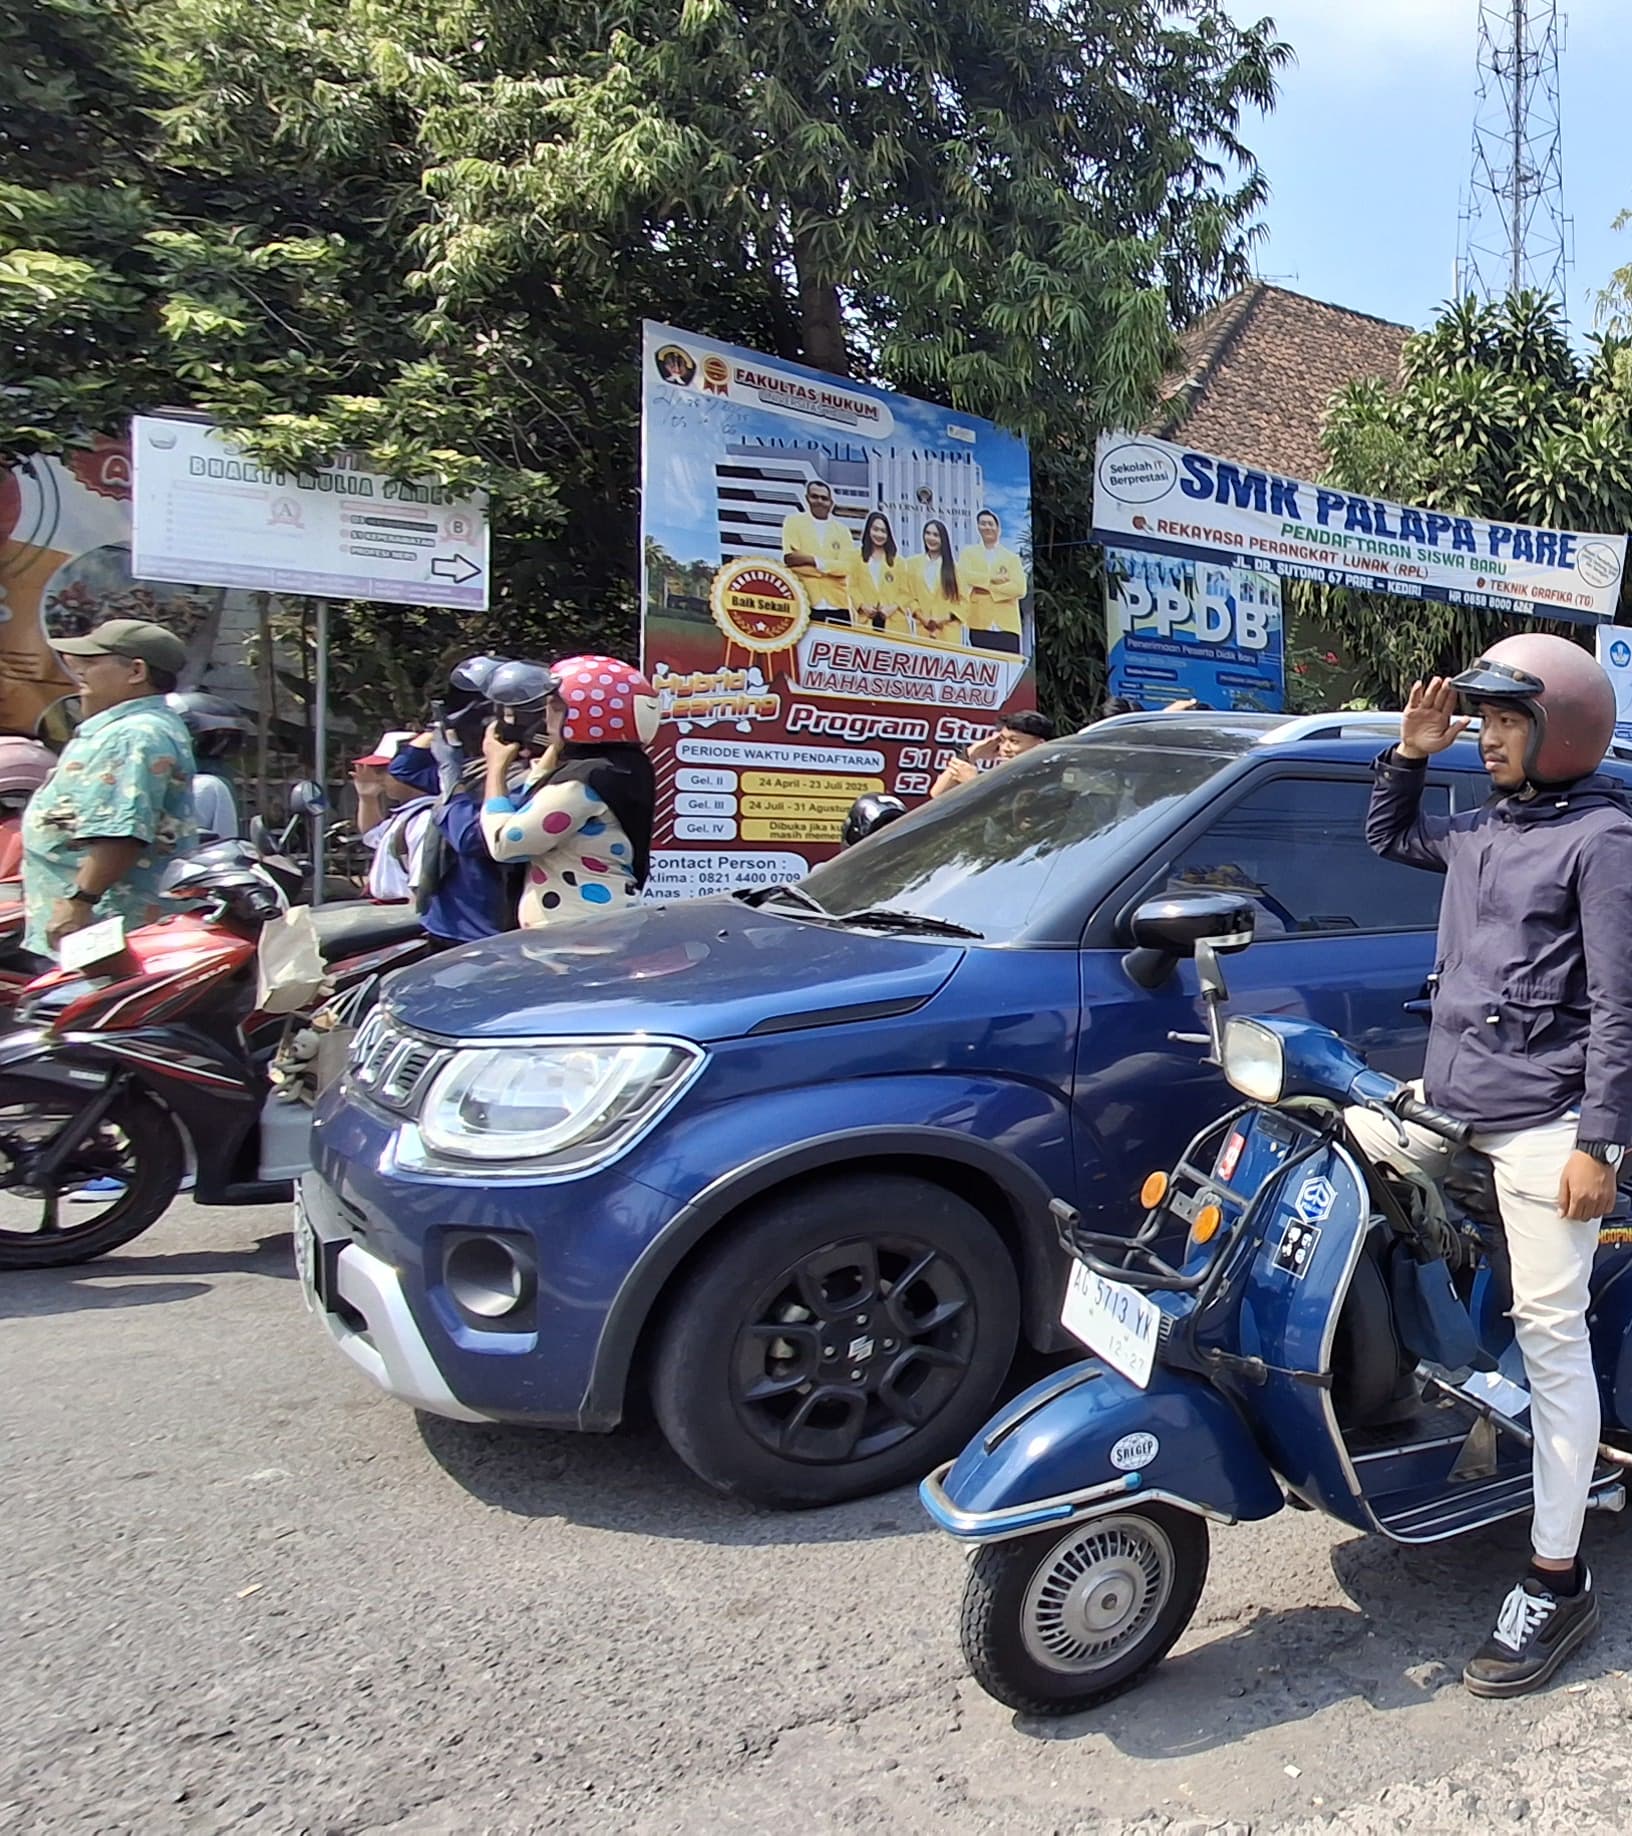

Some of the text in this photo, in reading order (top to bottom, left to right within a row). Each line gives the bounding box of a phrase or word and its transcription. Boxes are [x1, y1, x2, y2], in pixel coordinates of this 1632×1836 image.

[736, 368, 878, 419] FAKULTAS HUKUM
[190, 456, 286, 486] BHAKTI
[1110, 461, 1152, 474] Sekolah
[1109, 471, 1169, 487] Berprestasi
[1180, 453, 1302, 520] SMK
[1316, 488, 1477, 554] PALAPA
[1488, 524, 1578, 570] PARE
[453, 520, 464, 534] B
[1157, 518, 1429, 580] REKAYASA PERANGKAT LUNAK (RPL)
[1280, 522, 1508, 577] PENDAFTARAN SISWA BARU
[1277, 562, 1325, 583] SUTOMO
[1328, 571, 1342, 585] 67
[1345, 574, 1374, 590] PARE
[1387, 581, 1422, 597] KEDIRI
[1490, 579, 1528, 598] TEKNIK
[1531, 586, 1573, 603] GRAFIKA
[731, 595, 791, 613] Baik Sekali
[1117, 577, 1269, 650] PPDB
[1127, 637, 1181, 652] Penerimaan
[809, 641, 998, 686] PENERIMAAN
[653, 670, 747, 697] Hybrid
[805, 670, 997, 706] MAHASISWA BARU
[789, 705, 928, 741] Program
[681, 745, 880, 767] PERIODE WAKTU PENDAFTARAN
[690, 775, 714, 786] Gel.
[759, 777, 772, 787] 24
[774, 778, 800, 790] April
[809, 780, 821, 790] 23
[824, 780, 843, 791] Juli
[845, 781, 868, 791] 2025
[894, 772, 931, 794] S2
[688, 799, 712, 810] Gel.
[749, 801, 762, 810] 24
[764, 802, 785, 811] Juli
[794, 804, 806, 812] 31
[686, 823, 724, 834] Gel. IV
[769, 822, 807, 831] Dibuka
[809, 823, 828, 832] jika
[718, 856, 776, 870] Person
[699, 872, 730, 884] 0821
[735, 872, 767, 884] 4400
[770, 872, 801, 884] 0709
[643, 887, 681, 898] Anas
[1073, 1264, 1091, 1297] AG
[1094, 1278, 1129, 1324] 5713
